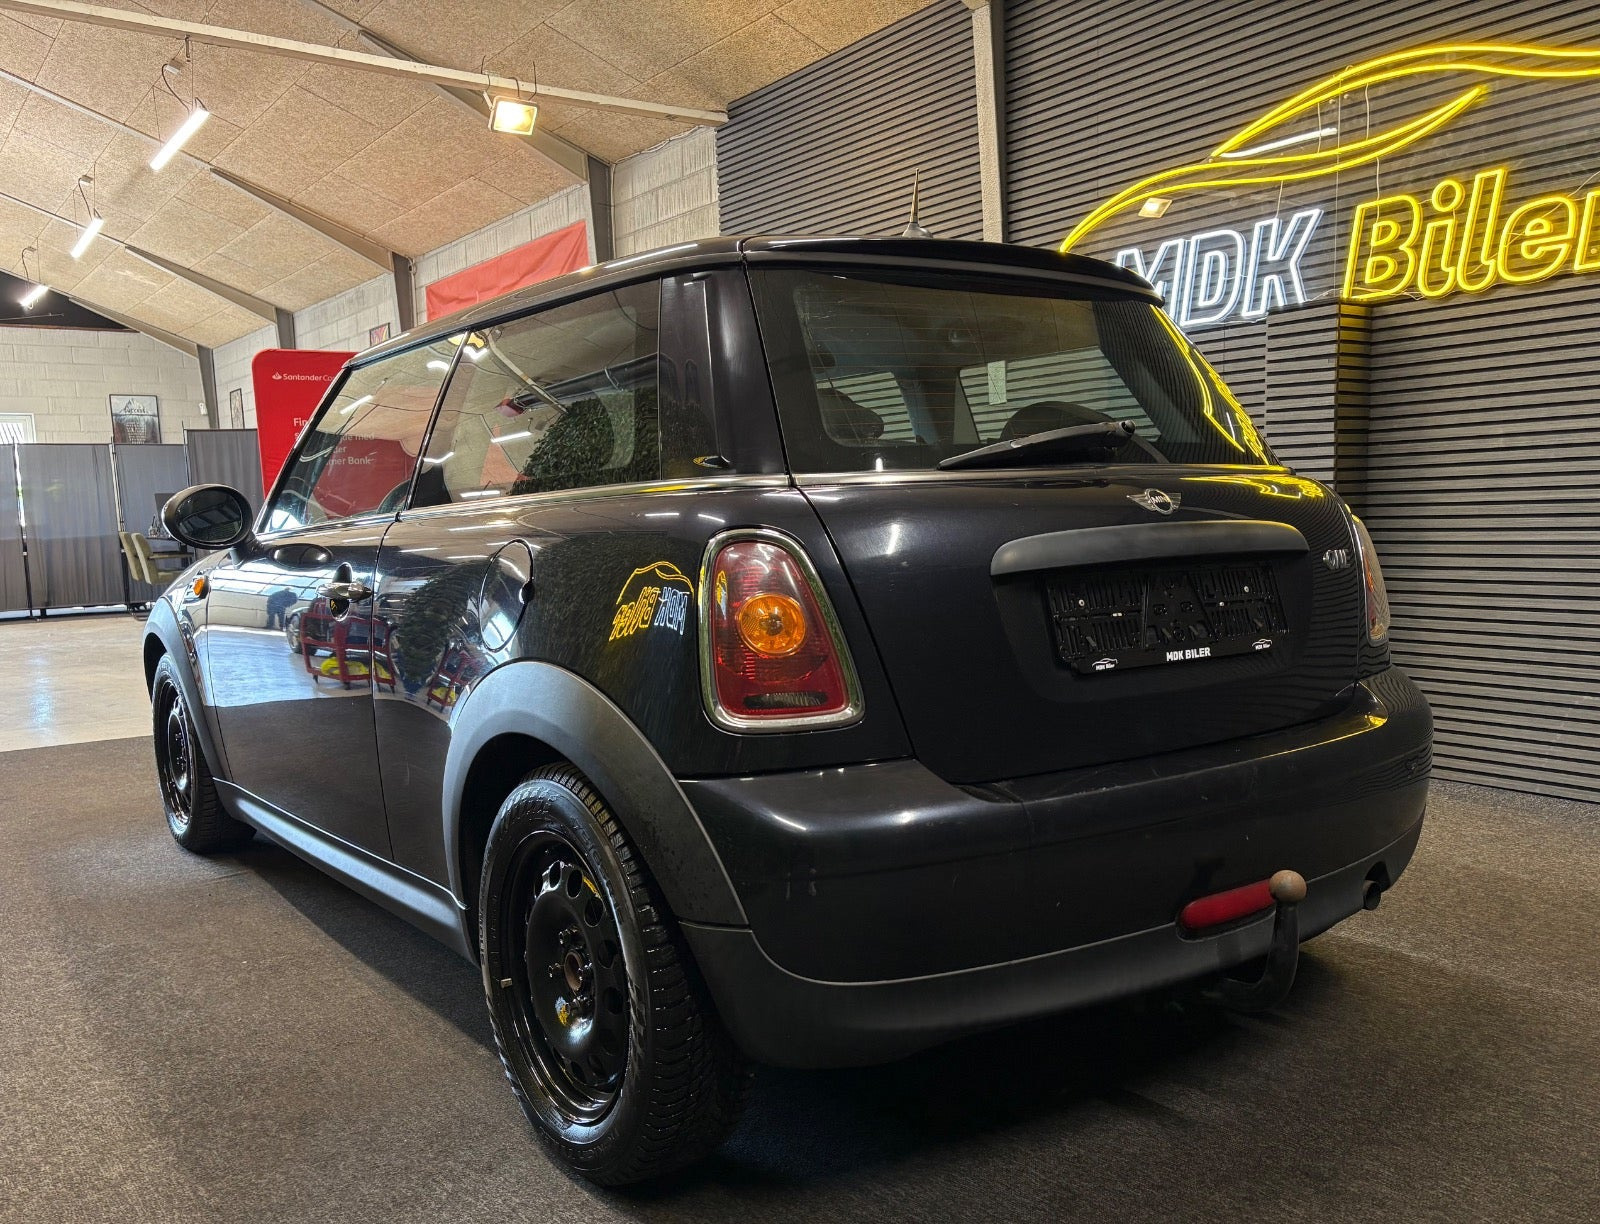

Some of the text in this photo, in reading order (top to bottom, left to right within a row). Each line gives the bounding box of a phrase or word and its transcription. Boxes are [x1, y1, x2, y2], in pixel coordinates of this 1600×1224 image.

[1116, 208, 1325, 327] MDK
[283, 373, 322, 381] Santander
[347, 456, 371, 465] Bank
[1166, 646, 1211, 662] MDK BILER
